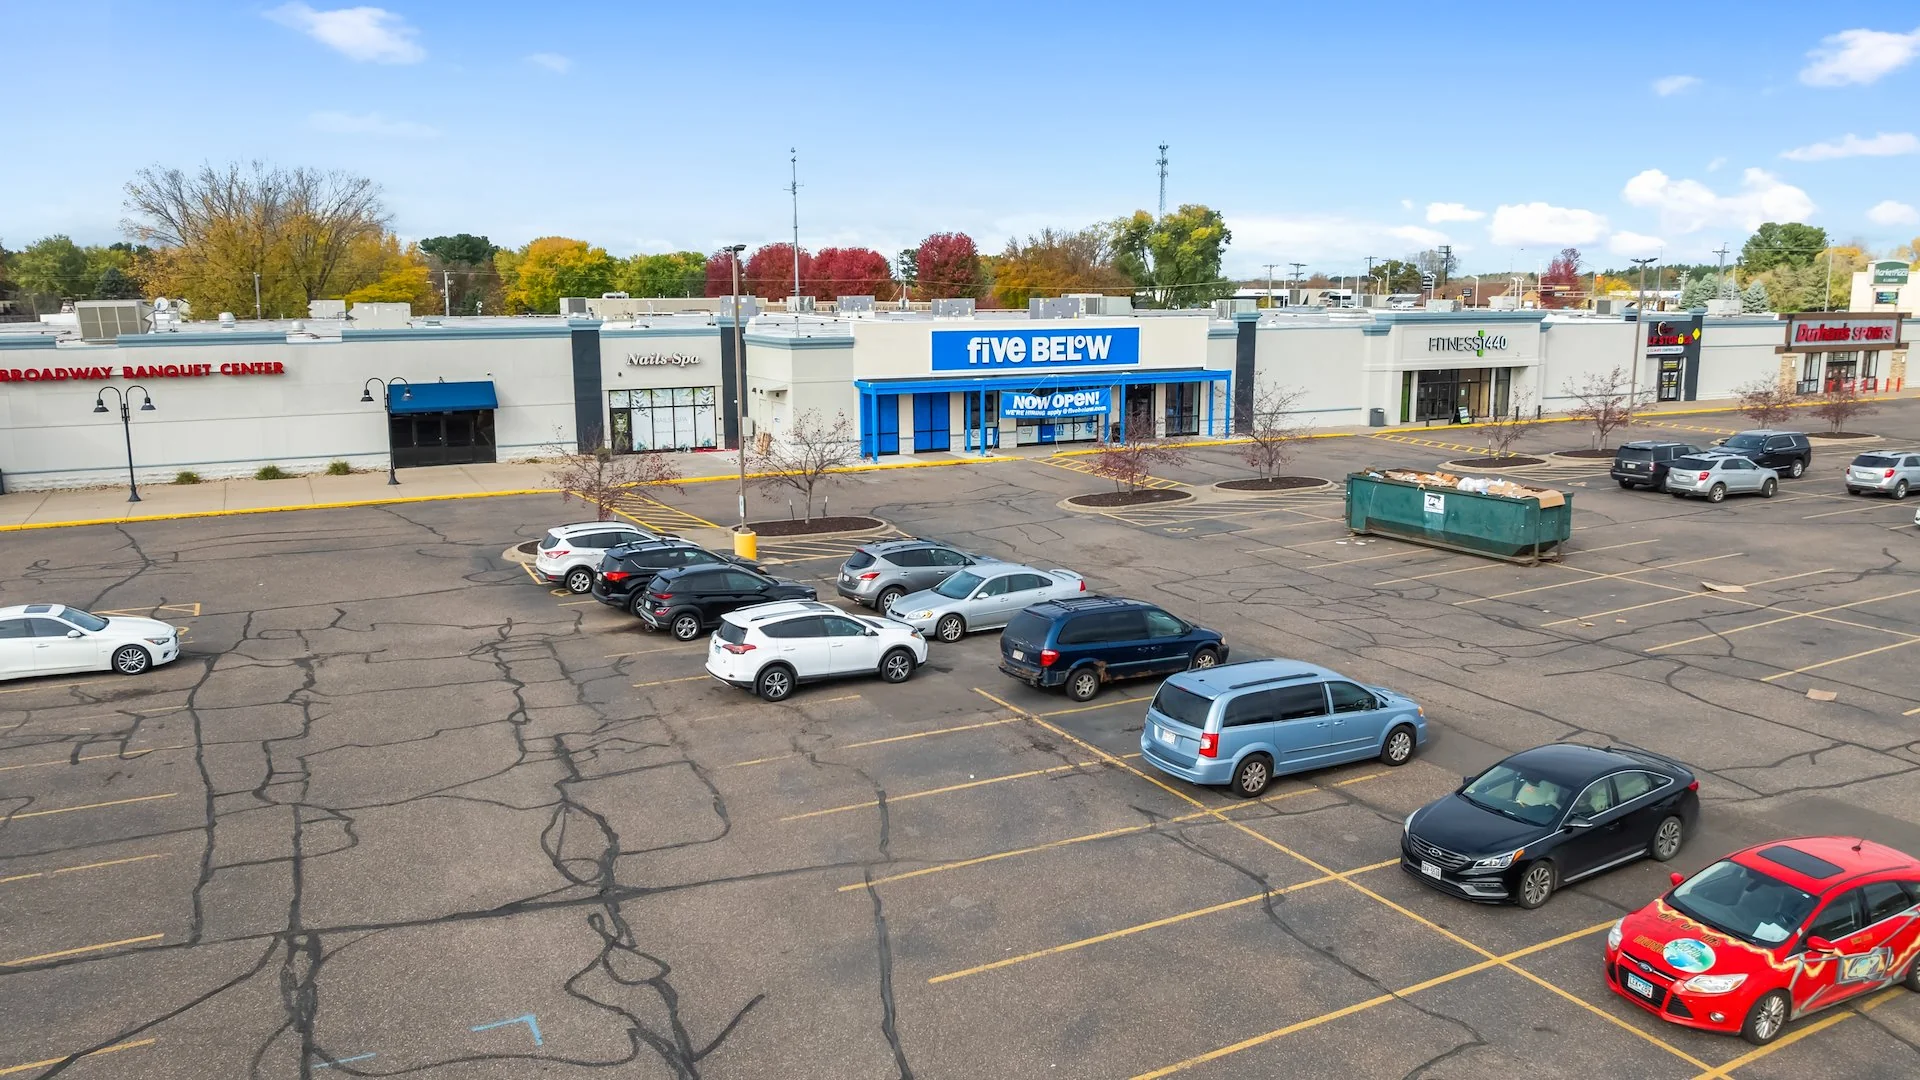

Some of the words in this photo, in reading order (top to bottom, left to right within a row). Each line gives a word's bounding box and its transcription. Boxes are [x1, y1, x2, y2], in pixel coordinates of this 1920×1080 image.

[1852, 326, 1893, 340] SPORTS
[626, 352, 668, 366] Nails
[672, 351, 701, 367] Spa
[0, 367, 113, 382] BROADWAY
[123, 363, 212, 379] BANQUET
[220, 362, 285, 376] CENTER
[1013, 395, 1051, 410] NOW
